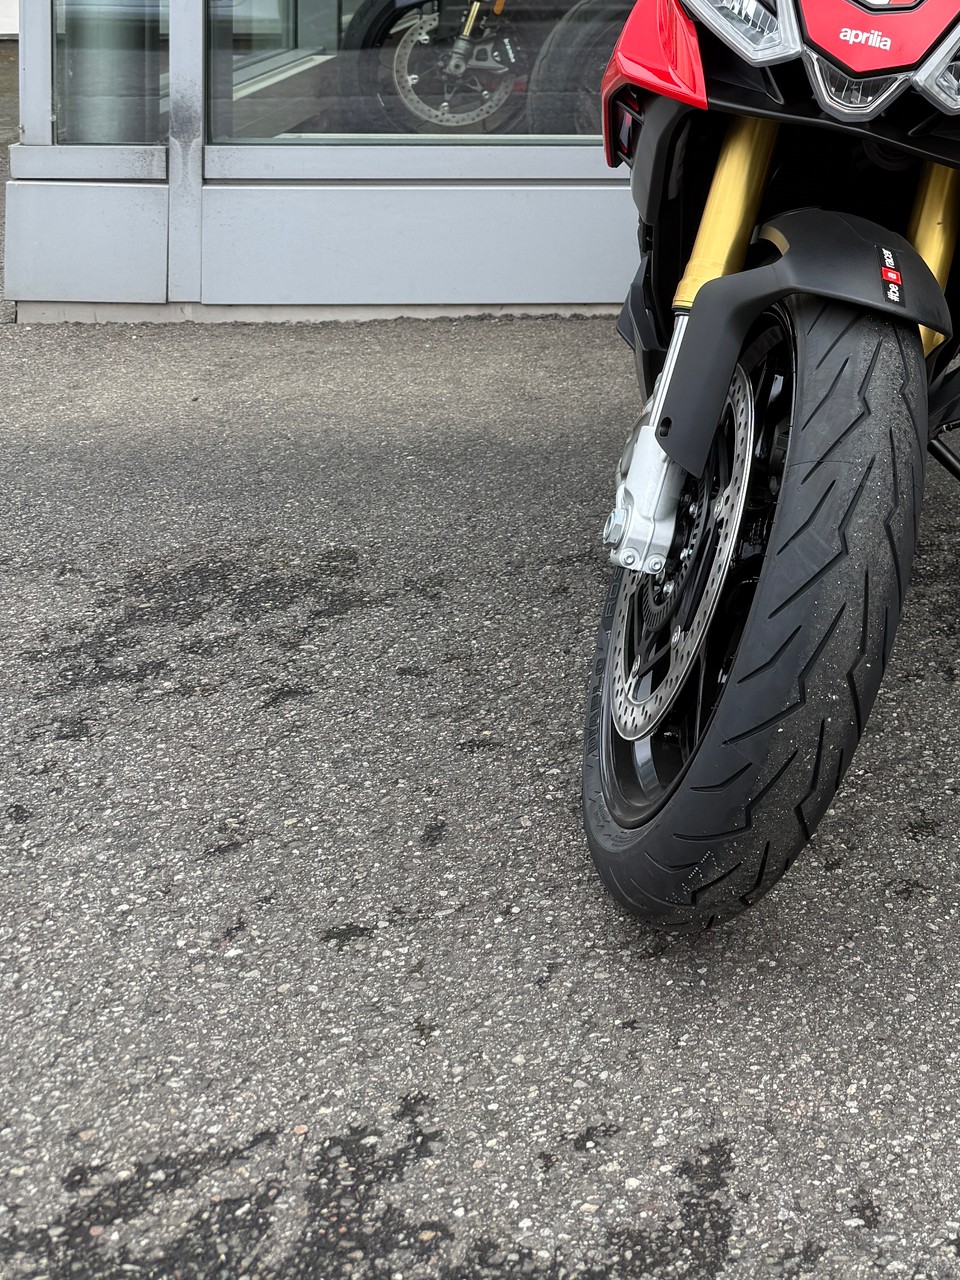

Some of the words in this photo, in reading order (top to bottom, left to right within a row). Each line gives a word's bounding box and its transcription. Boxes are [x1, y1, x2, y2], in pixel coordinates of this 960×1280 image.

[839, 27, 892, 51] aprilia
[882, 248, 895, 268] racer
[587, 658, 603, 755] DIABLO
